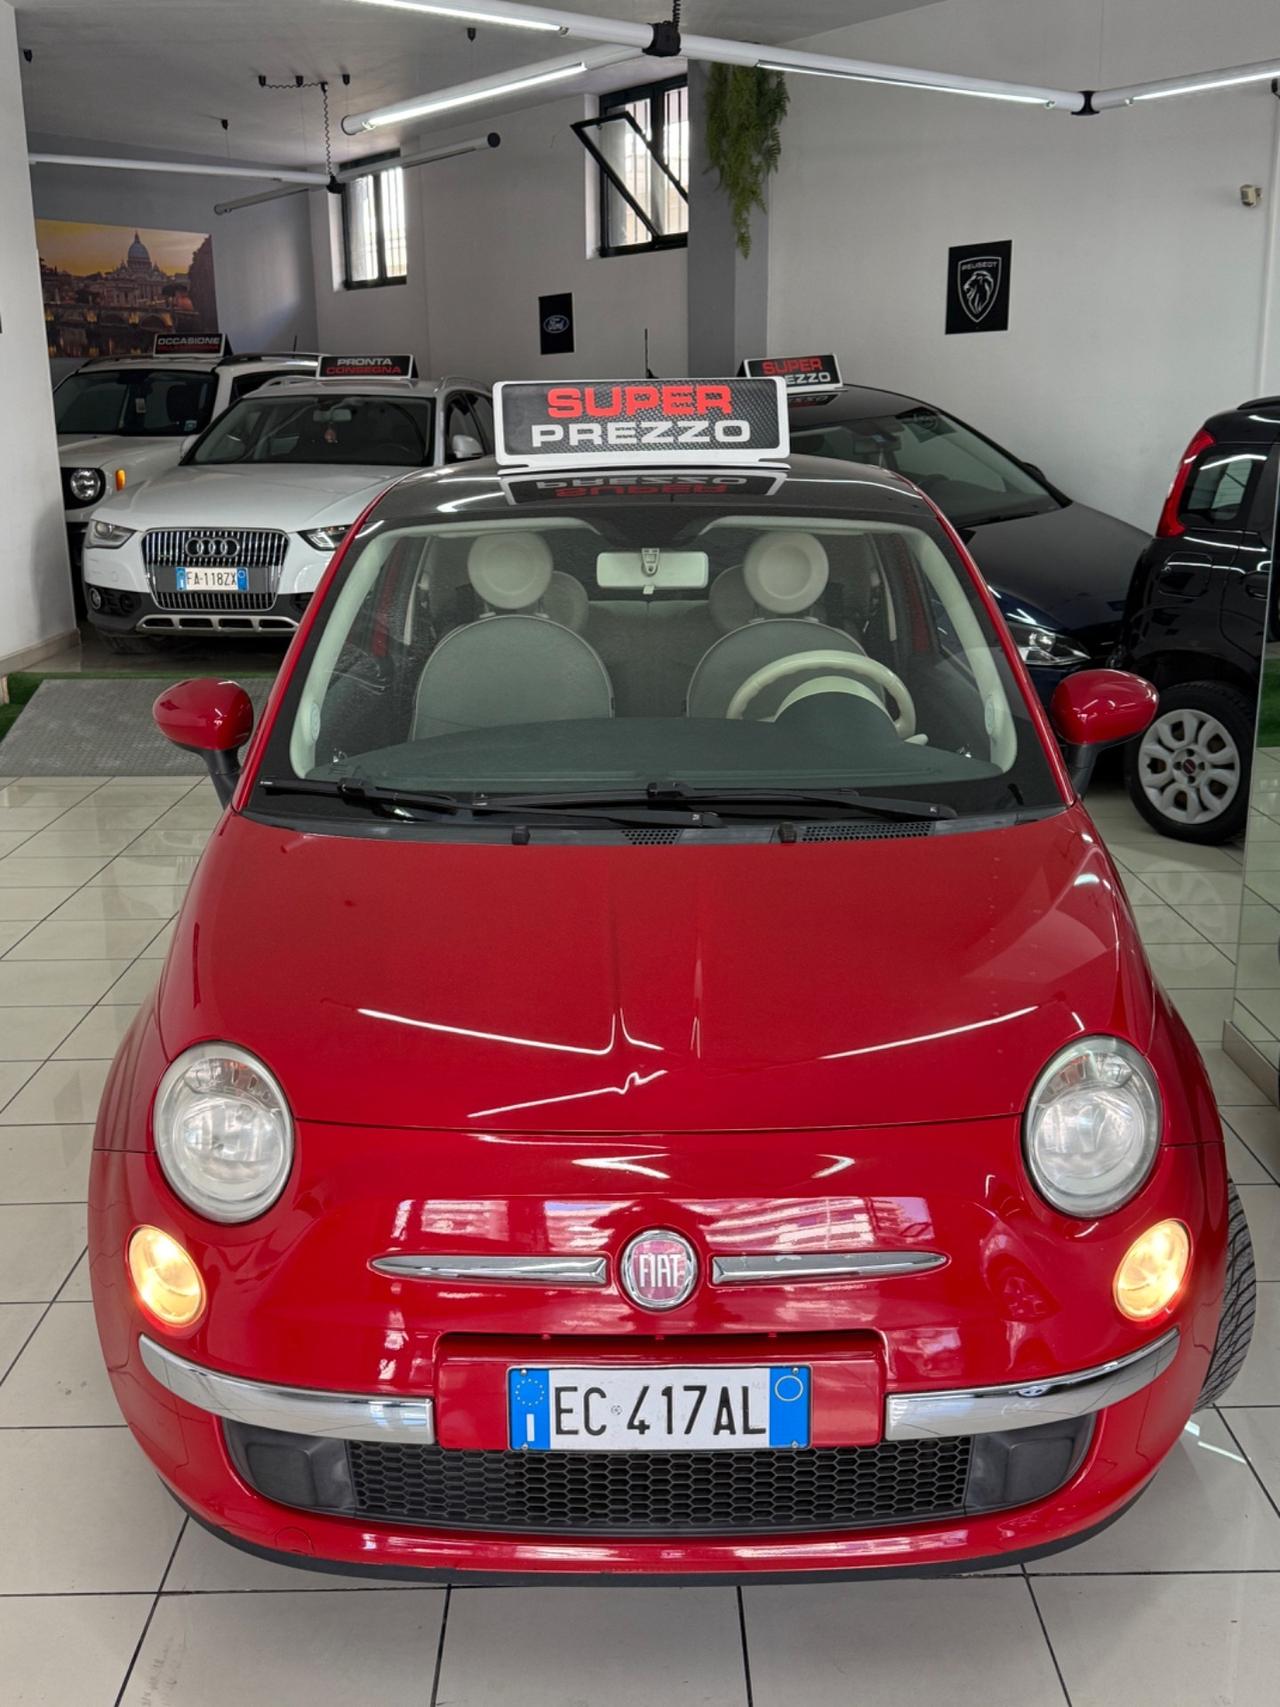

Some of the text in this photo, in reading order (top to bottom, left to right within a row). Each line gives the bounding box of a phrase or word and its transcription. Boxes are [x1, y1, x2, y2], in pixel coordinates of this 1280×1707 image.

[962, 261, 998, 271] PEUGEOT
[157, 336, 220, 345] OCCASIONE
[337, 358, 393, 366] PRONTA
[761, 357, 822, 374] SUPER
[326, 366, 402, 375] CONSEGNA
[784, 371, 831, 385] EZZO
[547, 384, 732, 418] SUPER
[531, 419, 751, 448] PREZZO
[639, 1253, 682, 1288] FIAT
